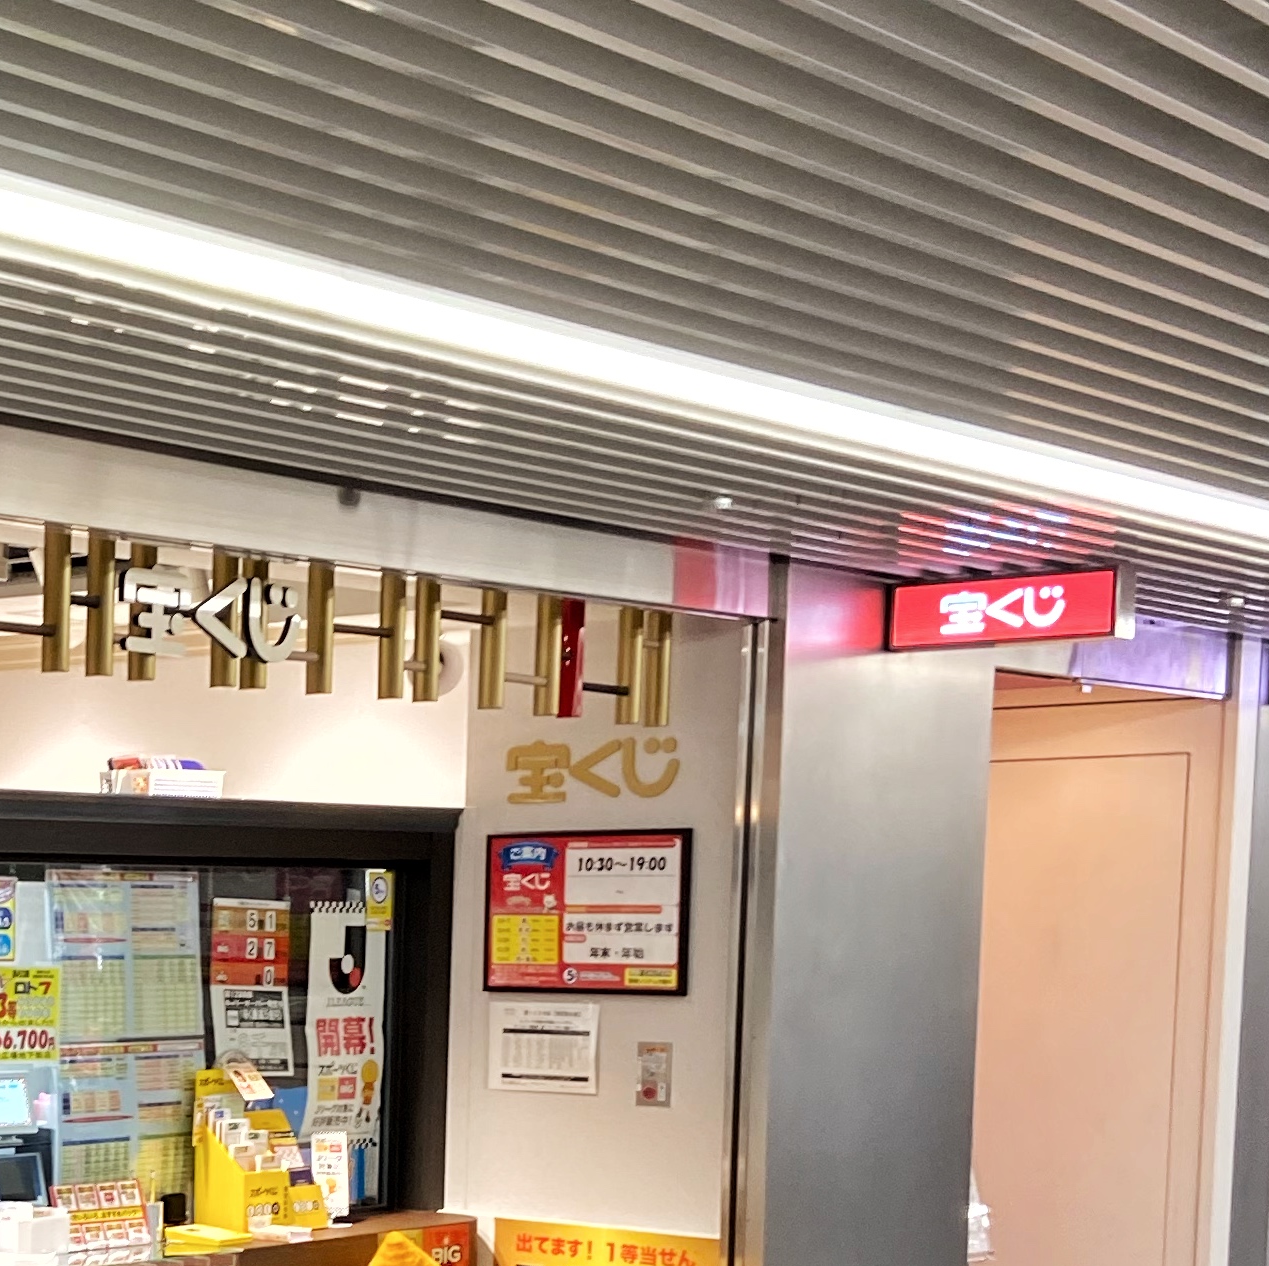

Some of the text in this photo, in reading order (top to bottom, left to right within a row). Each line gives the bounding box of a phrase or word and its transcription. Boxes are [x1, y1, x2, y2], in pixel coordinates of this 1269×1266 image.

[120, 563, 302, 663] 宝くじ
[939, 585, 1066, 635] 宝くじ
[506, 736, 681, 805] 宝くじ
[502, 873, 551, 891] 宝くじ
[248, 912, 273, 928] 5 1
[247, 940, 274, 956] 2 7
[265, 968, 272, 985] 0
[14, 981, 52, 995] ロト7
[315, 1016, 376, 1057] 開幕!
[431, 1244, 462, 1265] BIG
[516, 1232, 593, 1261] 出てます!
